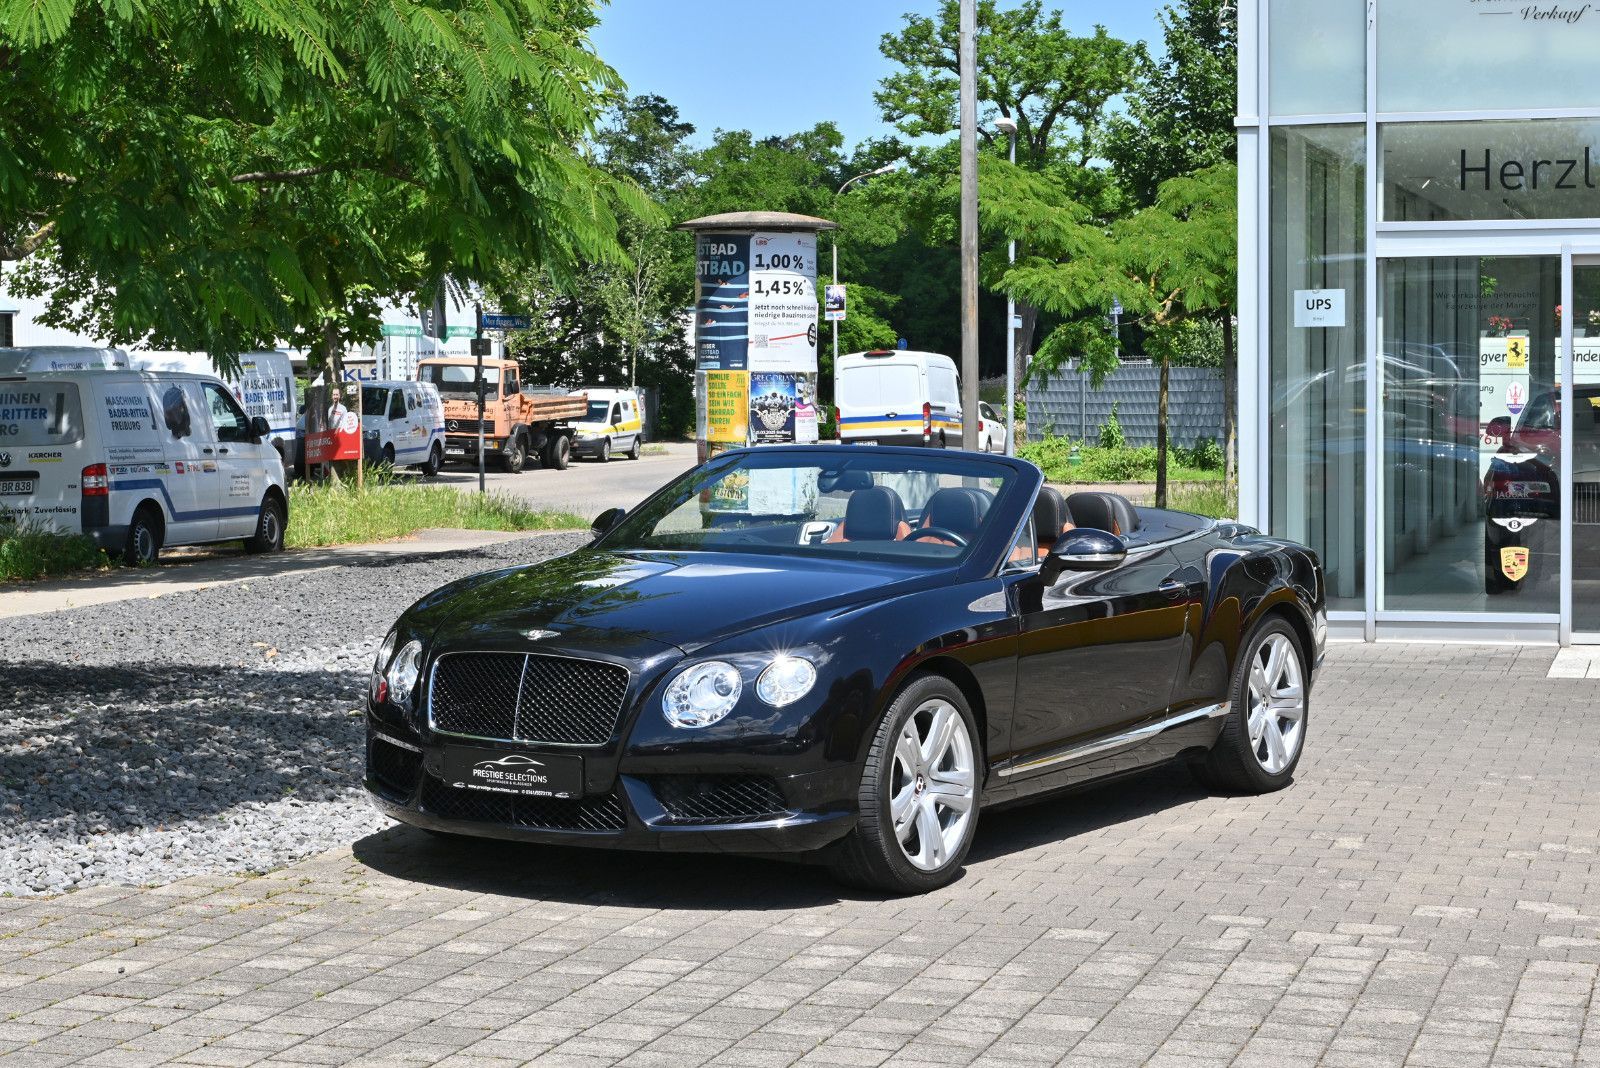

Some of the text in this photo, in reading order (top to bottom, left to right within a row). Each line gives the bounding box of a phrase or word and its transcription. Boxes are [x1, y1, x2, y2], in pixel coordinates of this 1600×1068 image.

[1520, 4, 1591, 23] Verkauf
[1306, 298, 1332, 310] UPS
[754, 311, 780, 319] niedrige
[104, 397, 143, 405] MASCHINEN
[108, 408, 149, 418] BADER-RITTER
[111, 421, 141, 431] FREIBURG
[15, 481, 31, 492] 838
[34, 506, 77, 514] Zuverlässig
[473, 768, 548, 783] PRESTIGE SELECTIONS
